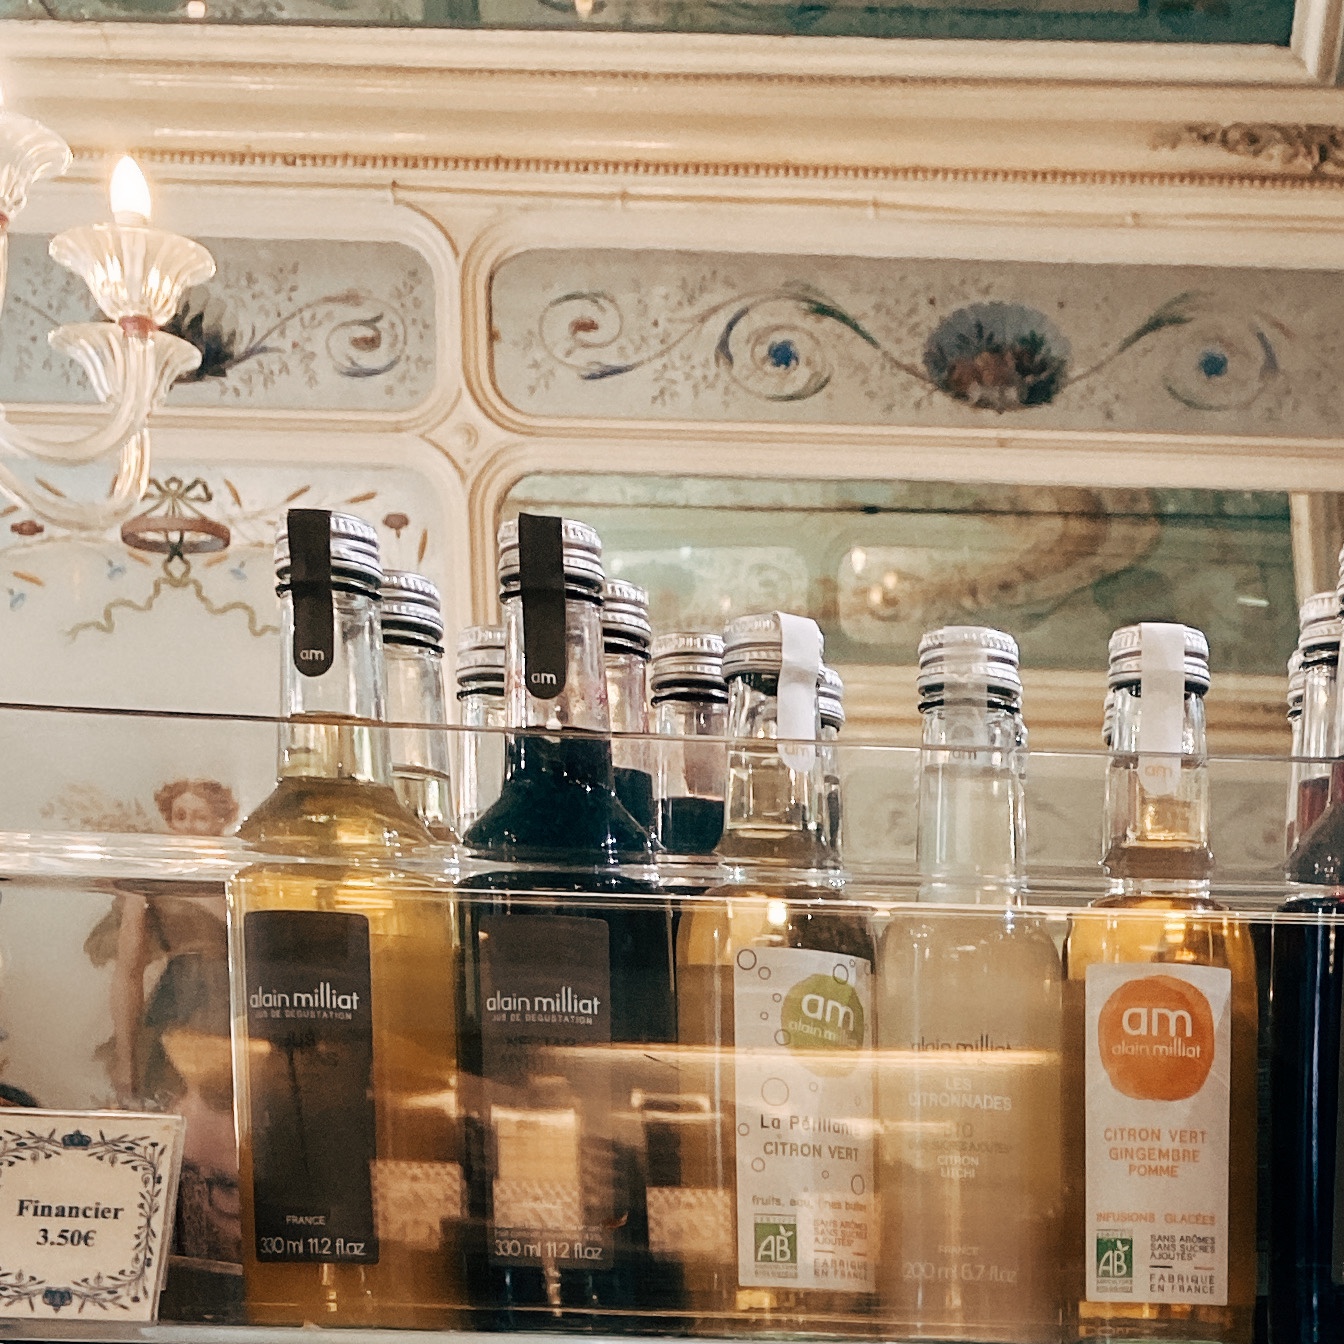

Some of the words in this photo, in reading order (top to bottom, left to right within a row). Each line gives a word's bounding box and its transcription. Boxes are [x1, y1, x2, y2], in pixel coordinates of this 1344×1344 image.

[300, 649, 325, 661] am
[531, 672, 557, 685] am
[250, 986, 289, 1008] alain
[294, 982, 359, 1010] milliat
[487, 990, 531, 1011] alain
[534, 986, 600, 1015] milliat
[801, 993, 854, 1031] am
[1122, 1007, 1193, 1037] am
[1111, 1041, 1151, 1057] alain
[1153, 1037, 1201, 1058] milliat
[761, 1114, 781, 1129] La
[1104, 1127, 1161, 1142] CITRON
[1168, 1129, 1207, 1144] VERT
[763, 1141, 822, 1158] CITRON
[828, 1146, 859, 1161] VERT
[1109, 1149, 1200, 1163] GINGEMBRE
[1128, 1164, 1179, 1178] POMME
[17, 1199, 124, 1220] Financier
[1096, 1212, 1155, 1224] INFUSIONS
[286, 1215, 326, 1225] FRANCE
[36, 1228, 97, 1247] 3.50€
[260, 1237, 285, 1254] 330
[287, 1239, 303, 1254] ml
[758, 1235, 791, 1261] AB
[1099, 1250, 1127, 1276] AB
[1150, 1284, 1165, 1293] EN
[1171, 1285, 1215, 1295] FRANCE
